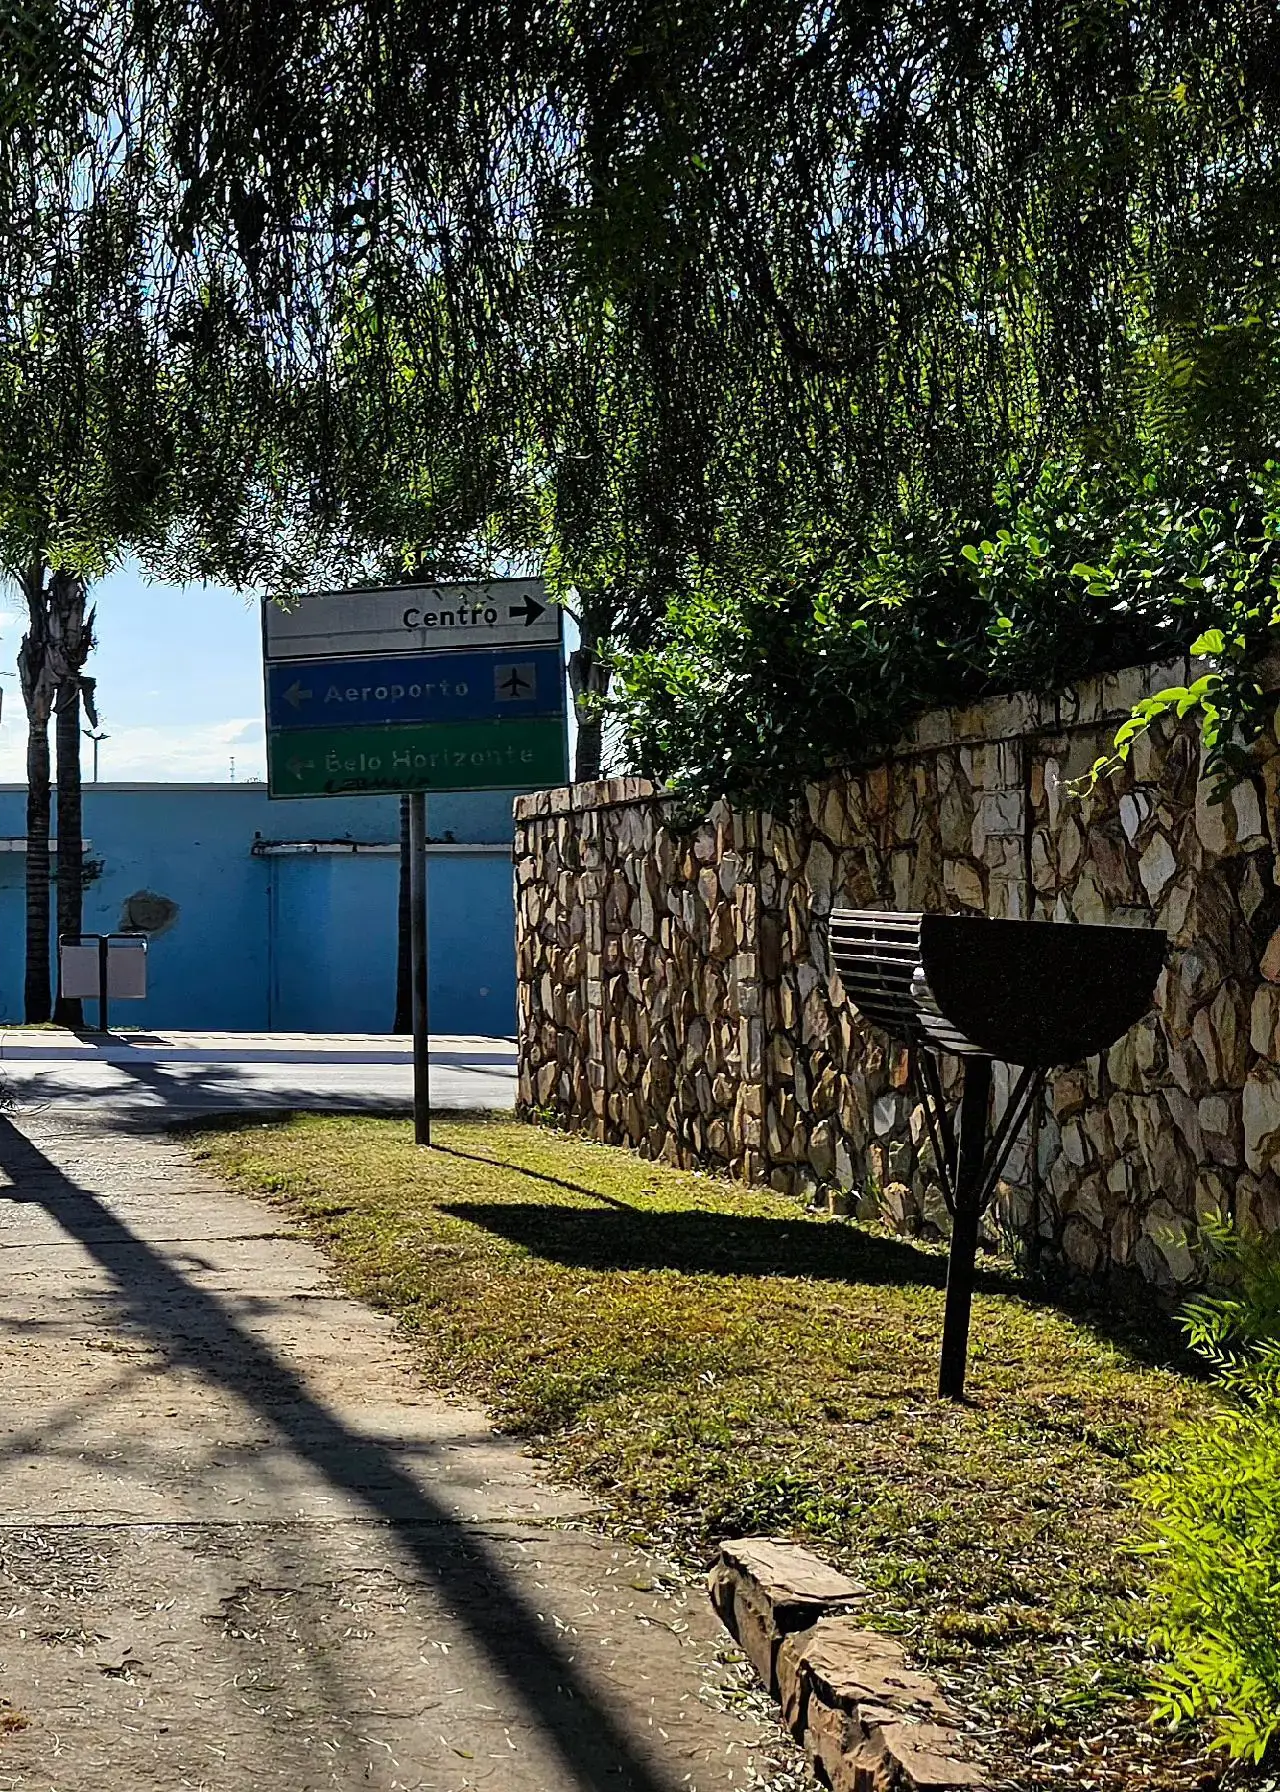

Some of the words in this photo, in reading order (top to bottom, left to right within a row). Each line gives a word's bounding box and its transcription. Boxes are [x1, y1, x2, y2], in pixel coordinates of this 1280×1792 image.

[403, 605, 498, 628] Centro
[323, 679, 469, 704] Aeroporto
[324, 750, 382, 773] Belo
[392, 745, 534, 770] Horizonte
